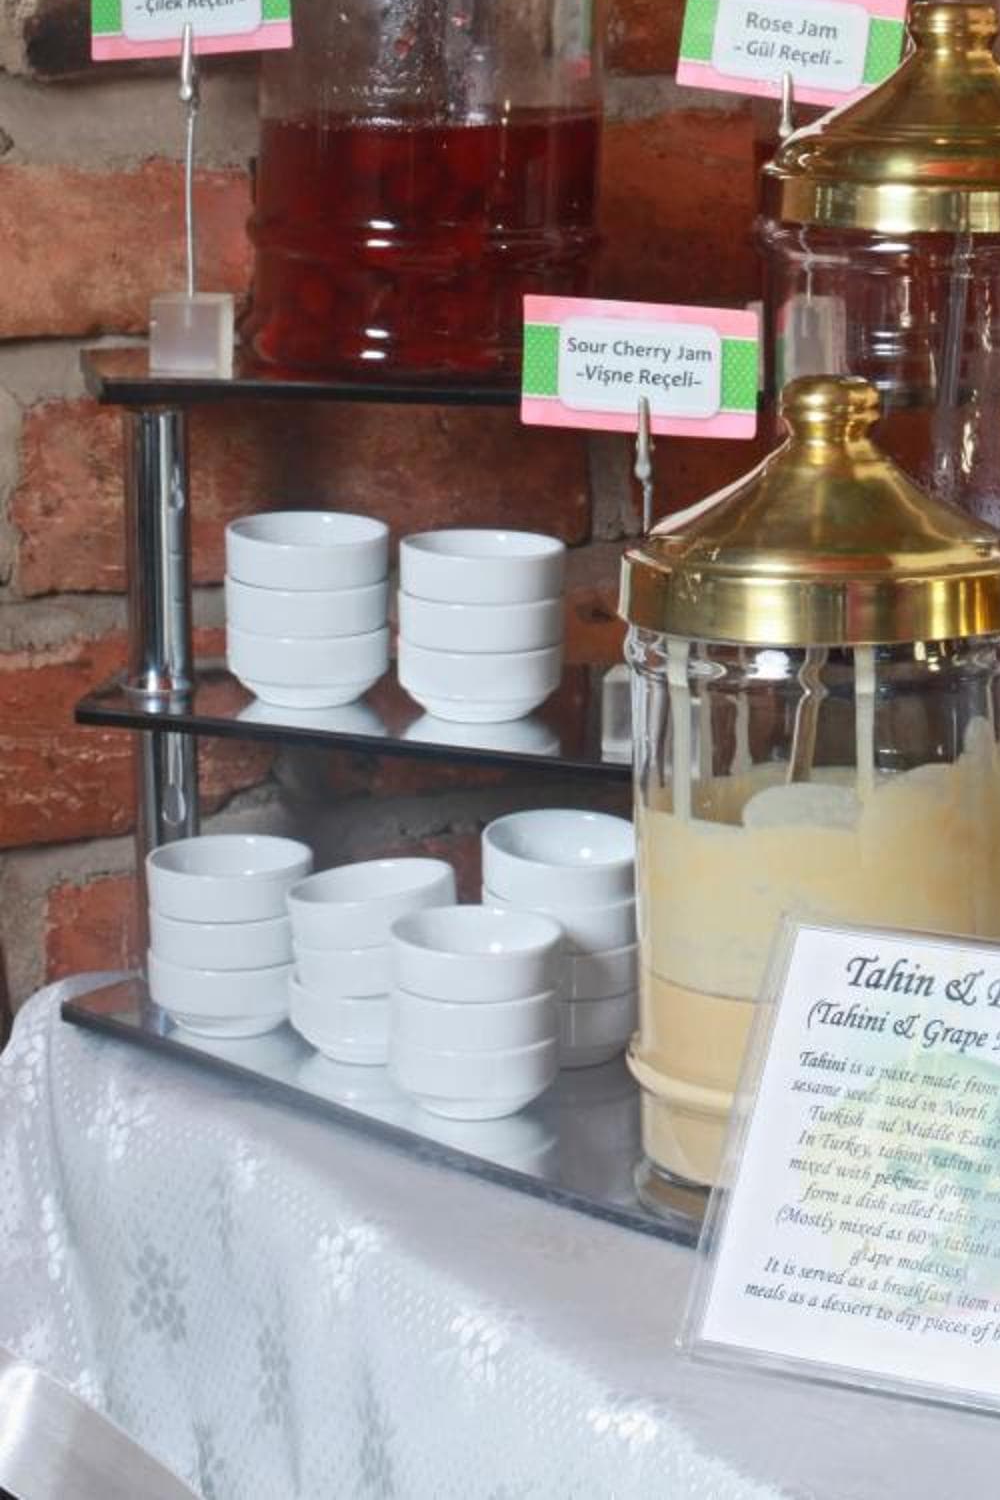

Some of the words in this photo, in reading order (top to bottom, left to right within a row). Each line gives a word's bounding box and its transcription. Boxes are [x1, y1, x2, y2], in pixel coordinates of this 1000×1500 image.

[746, 11, 793, 34] Rose
[797, 20, 838, 39] Jam
[746, 40, 775, 58] Gül
[779, 44, 831, 67] Reçeli
[567, 337, 607, 354] Sour
[612, 340, 671, 364] Cherry
[677, 346, 712, 361] Jam
[846, 956, 935, 1000] Tahin
[945, 969, 985, 1006] &
[807, 1000, 891, 1034] (Tahini
[892, 1014, 920, 1039] &
[923, 1018, 989, 1049] Grape
[800, 1051, 848, 1074] Tahini
[850, 1062, 861, 1076] is
[866, 1066, 876, 1078] a
[879, 1067, 916, 1085] paste
[921, 1073, 961, 1090] made
[790, 1079, 841, 1097] sesame
[885, 1093, 921, 1110] used
[922, 1098, 938, 1113] in
[943, 1100, 989, 1120] North
[797, 1129, 816, 1146] In
[808, 1105, 864, 1128] Turkish
[903, 1119, 955, 1141] Middle
[788, 1157, 834, 1176] mixed
[836, 1164, 871, 1181] with
[872, 1169, 929, 1191] pekmez
[802, 1181, 839, 1203] form
[841, 1193, 851, 1205] a
[855, 1191, 887, 1211] dish
[889, 1198, 938, 1219] called
[776, 1203, 836, 1234] (Mostly
[839, 1221, 887, 1238] mixed
[886, 1228, 902, 1241] as
[764, 1256, 780, 1273] It
[783, 1262, 795, 1276] is
[798, 1266, 848, 1285] served
[848, 1277, 864, 1288] as
[867, 1280, 878, 1291] a
[881, 1275, 951, 1304] breakfast
[957, 1292, 990, 1311] item
[744, 1283, 787, 1301] meals
[788, 1294, 805, 1305] as
[807, 1296, 817, 1307] a
[821, 1293, 873, 1316] dessert
[876, 1306, 893, 1320] to
[895, 1307, 921, 1331] dip
[923, 1315, 969, 1335] pieces
[971, 1321, 995, 1344] of
